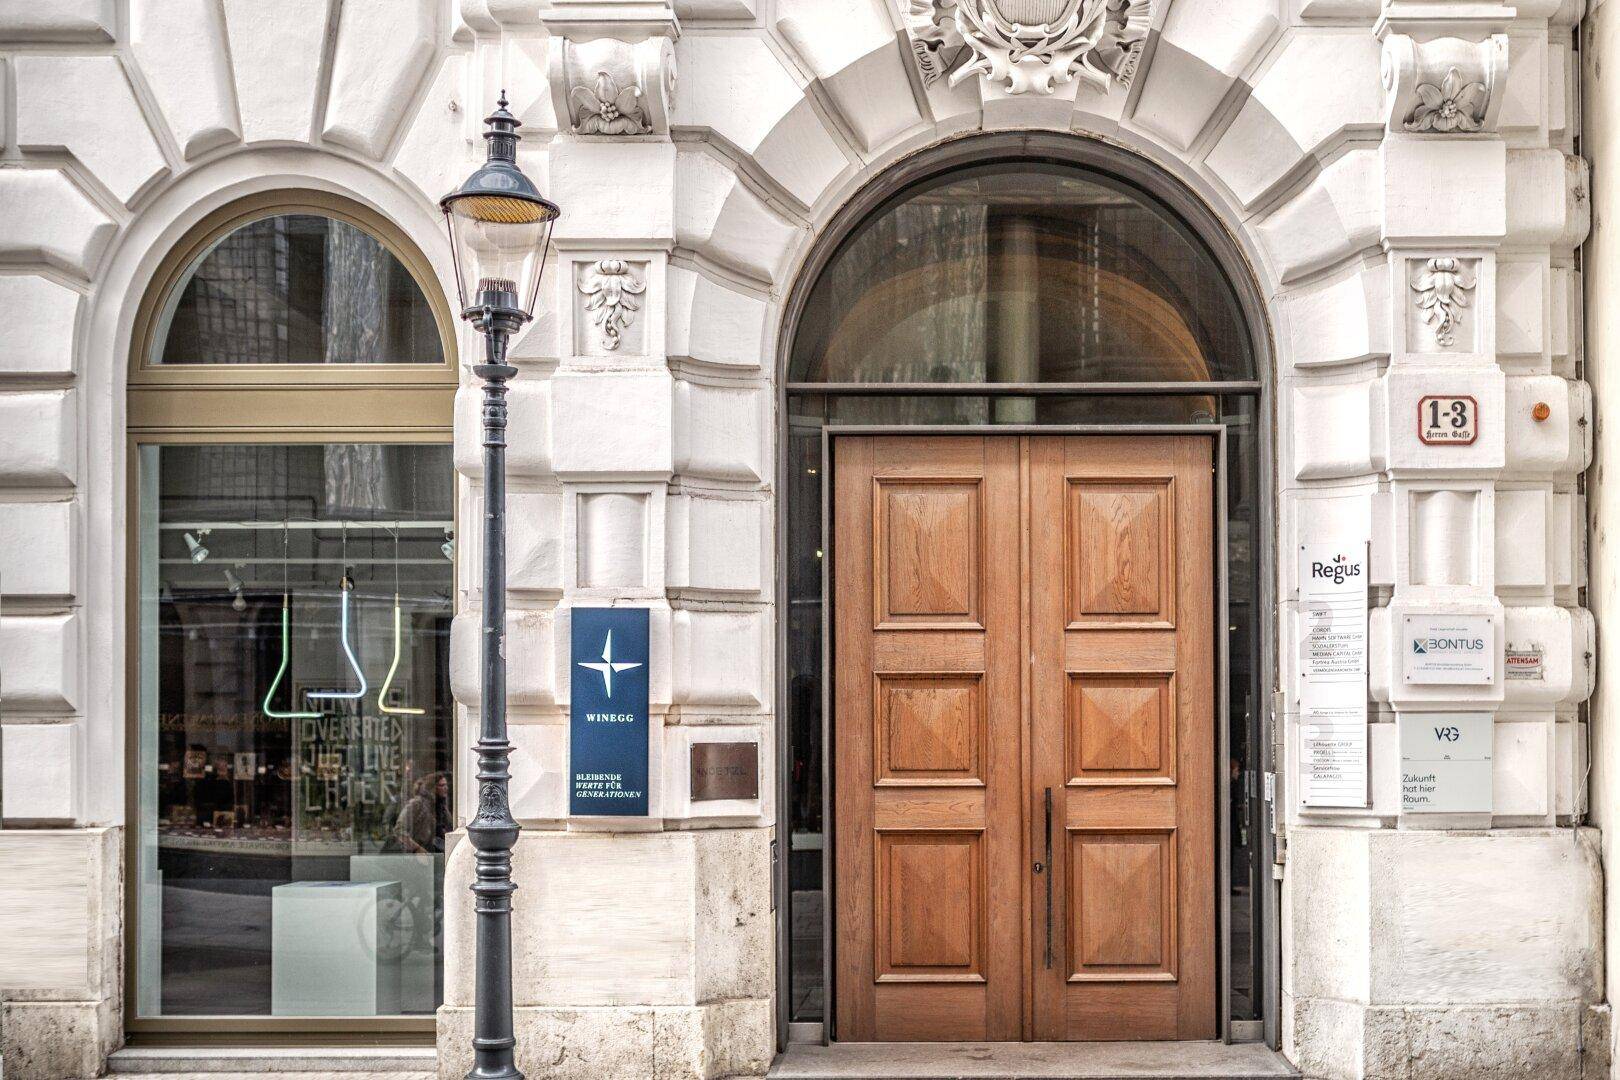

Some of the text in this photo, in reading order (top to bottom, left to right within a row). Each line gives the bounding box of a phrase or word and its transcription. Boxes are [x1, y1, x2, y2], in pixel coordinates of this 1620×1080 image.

[1429, 400, 1467, 429] 1-3
[1426, 430, 1448, 439] Herren
[1311, 561, 1361, 585] Regus
[1428, 638, 1484, 650] BONTUS
[1506, 657, 1539, 665] ATTENSAM
[302, 689, 359, 715] NOW
[585, 713, 635, 723] WINEGG
[301, 715, 403, 743] OVERRATED
[1434, 727, 1460, 742] VRG
[363, 744, 401, 771] LIVE
[575, 773, 623, 781] BLEIBENDE
[1402, 773, 1436, 783] Zukunft
[575, 780, 623, 790] WERTE FÜR
[1402, 784, 1436, 794] hat hier
[305, 772, 398, 812] LATER
[575, 790, 642, 798] GENERATIONEN
[1403, 794, 1431, 804] Raum.
